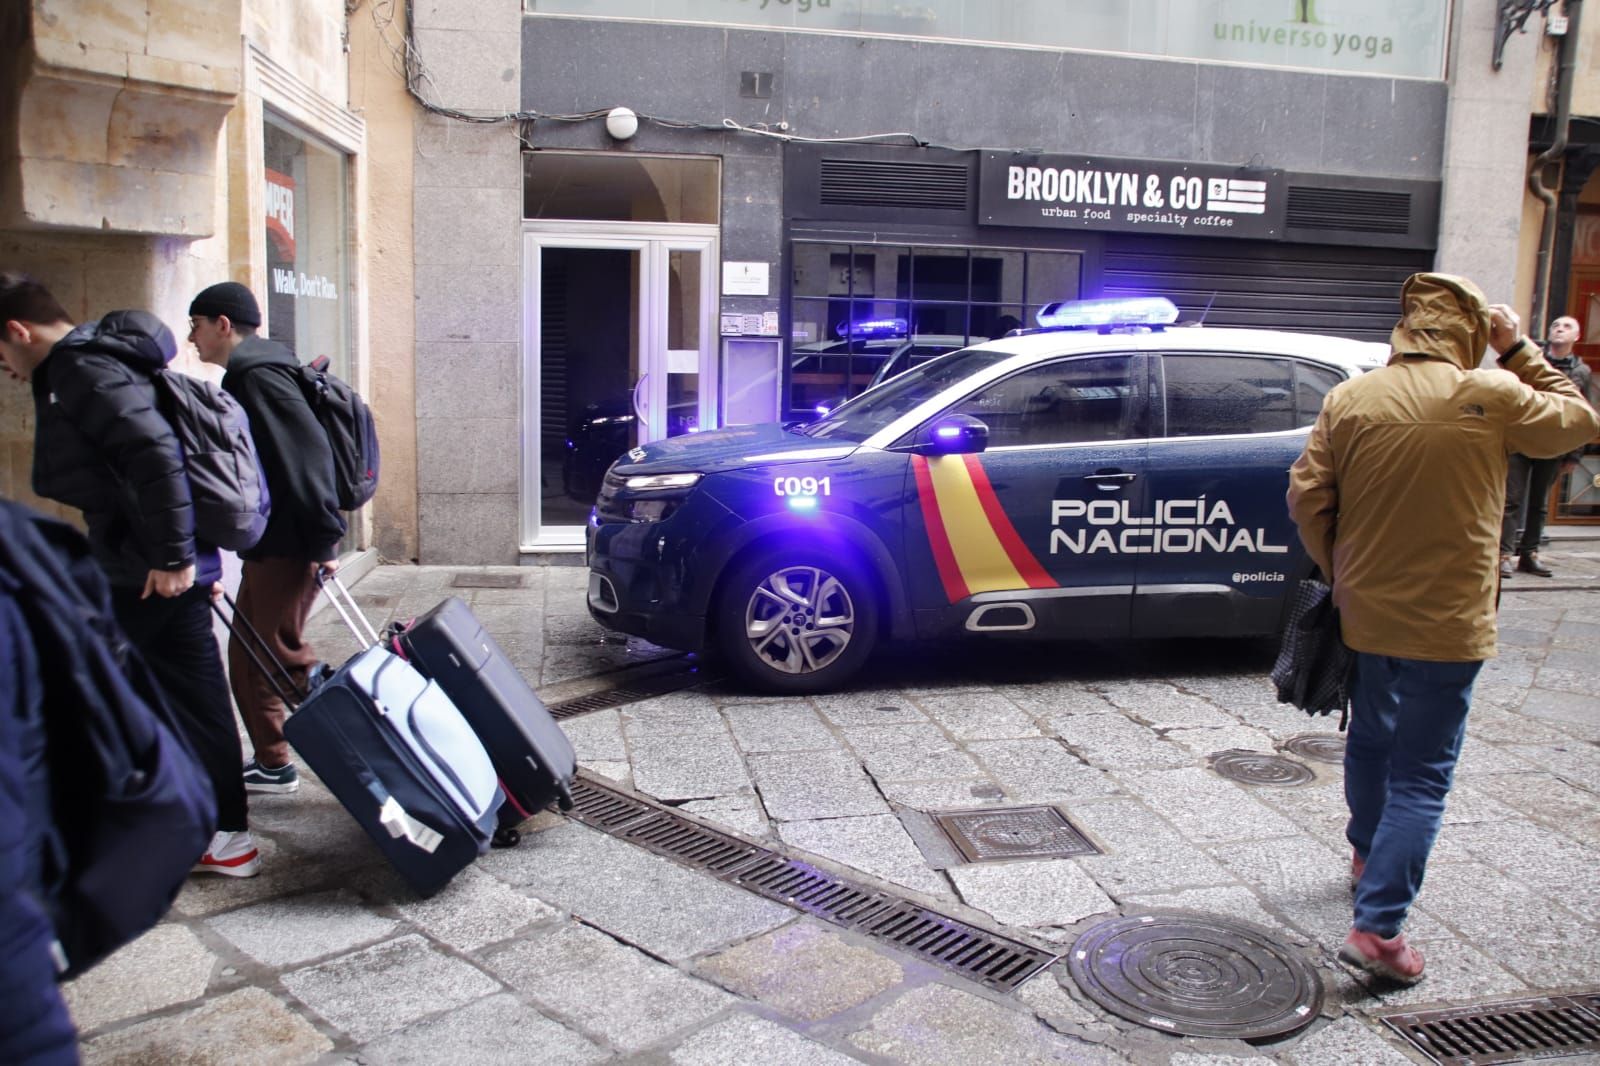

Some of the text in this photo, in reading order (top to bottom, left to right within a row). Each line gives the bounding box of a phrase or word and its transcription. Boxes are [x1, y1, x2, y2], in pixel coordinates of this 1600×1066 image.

[1007, 165, 1203, 210] BROOKLYN & CO
[1041, 207, 1234, 227] urban food specialty coffee
[273, 267, 299, 299] Walk,
[300, 272, 321, 297] Don't
[1051, 493, 1236, 526] POLICÍA
[1049, 527, 1289, 555] NACIONAL
[1231, 571, 1285, 584] @policia
